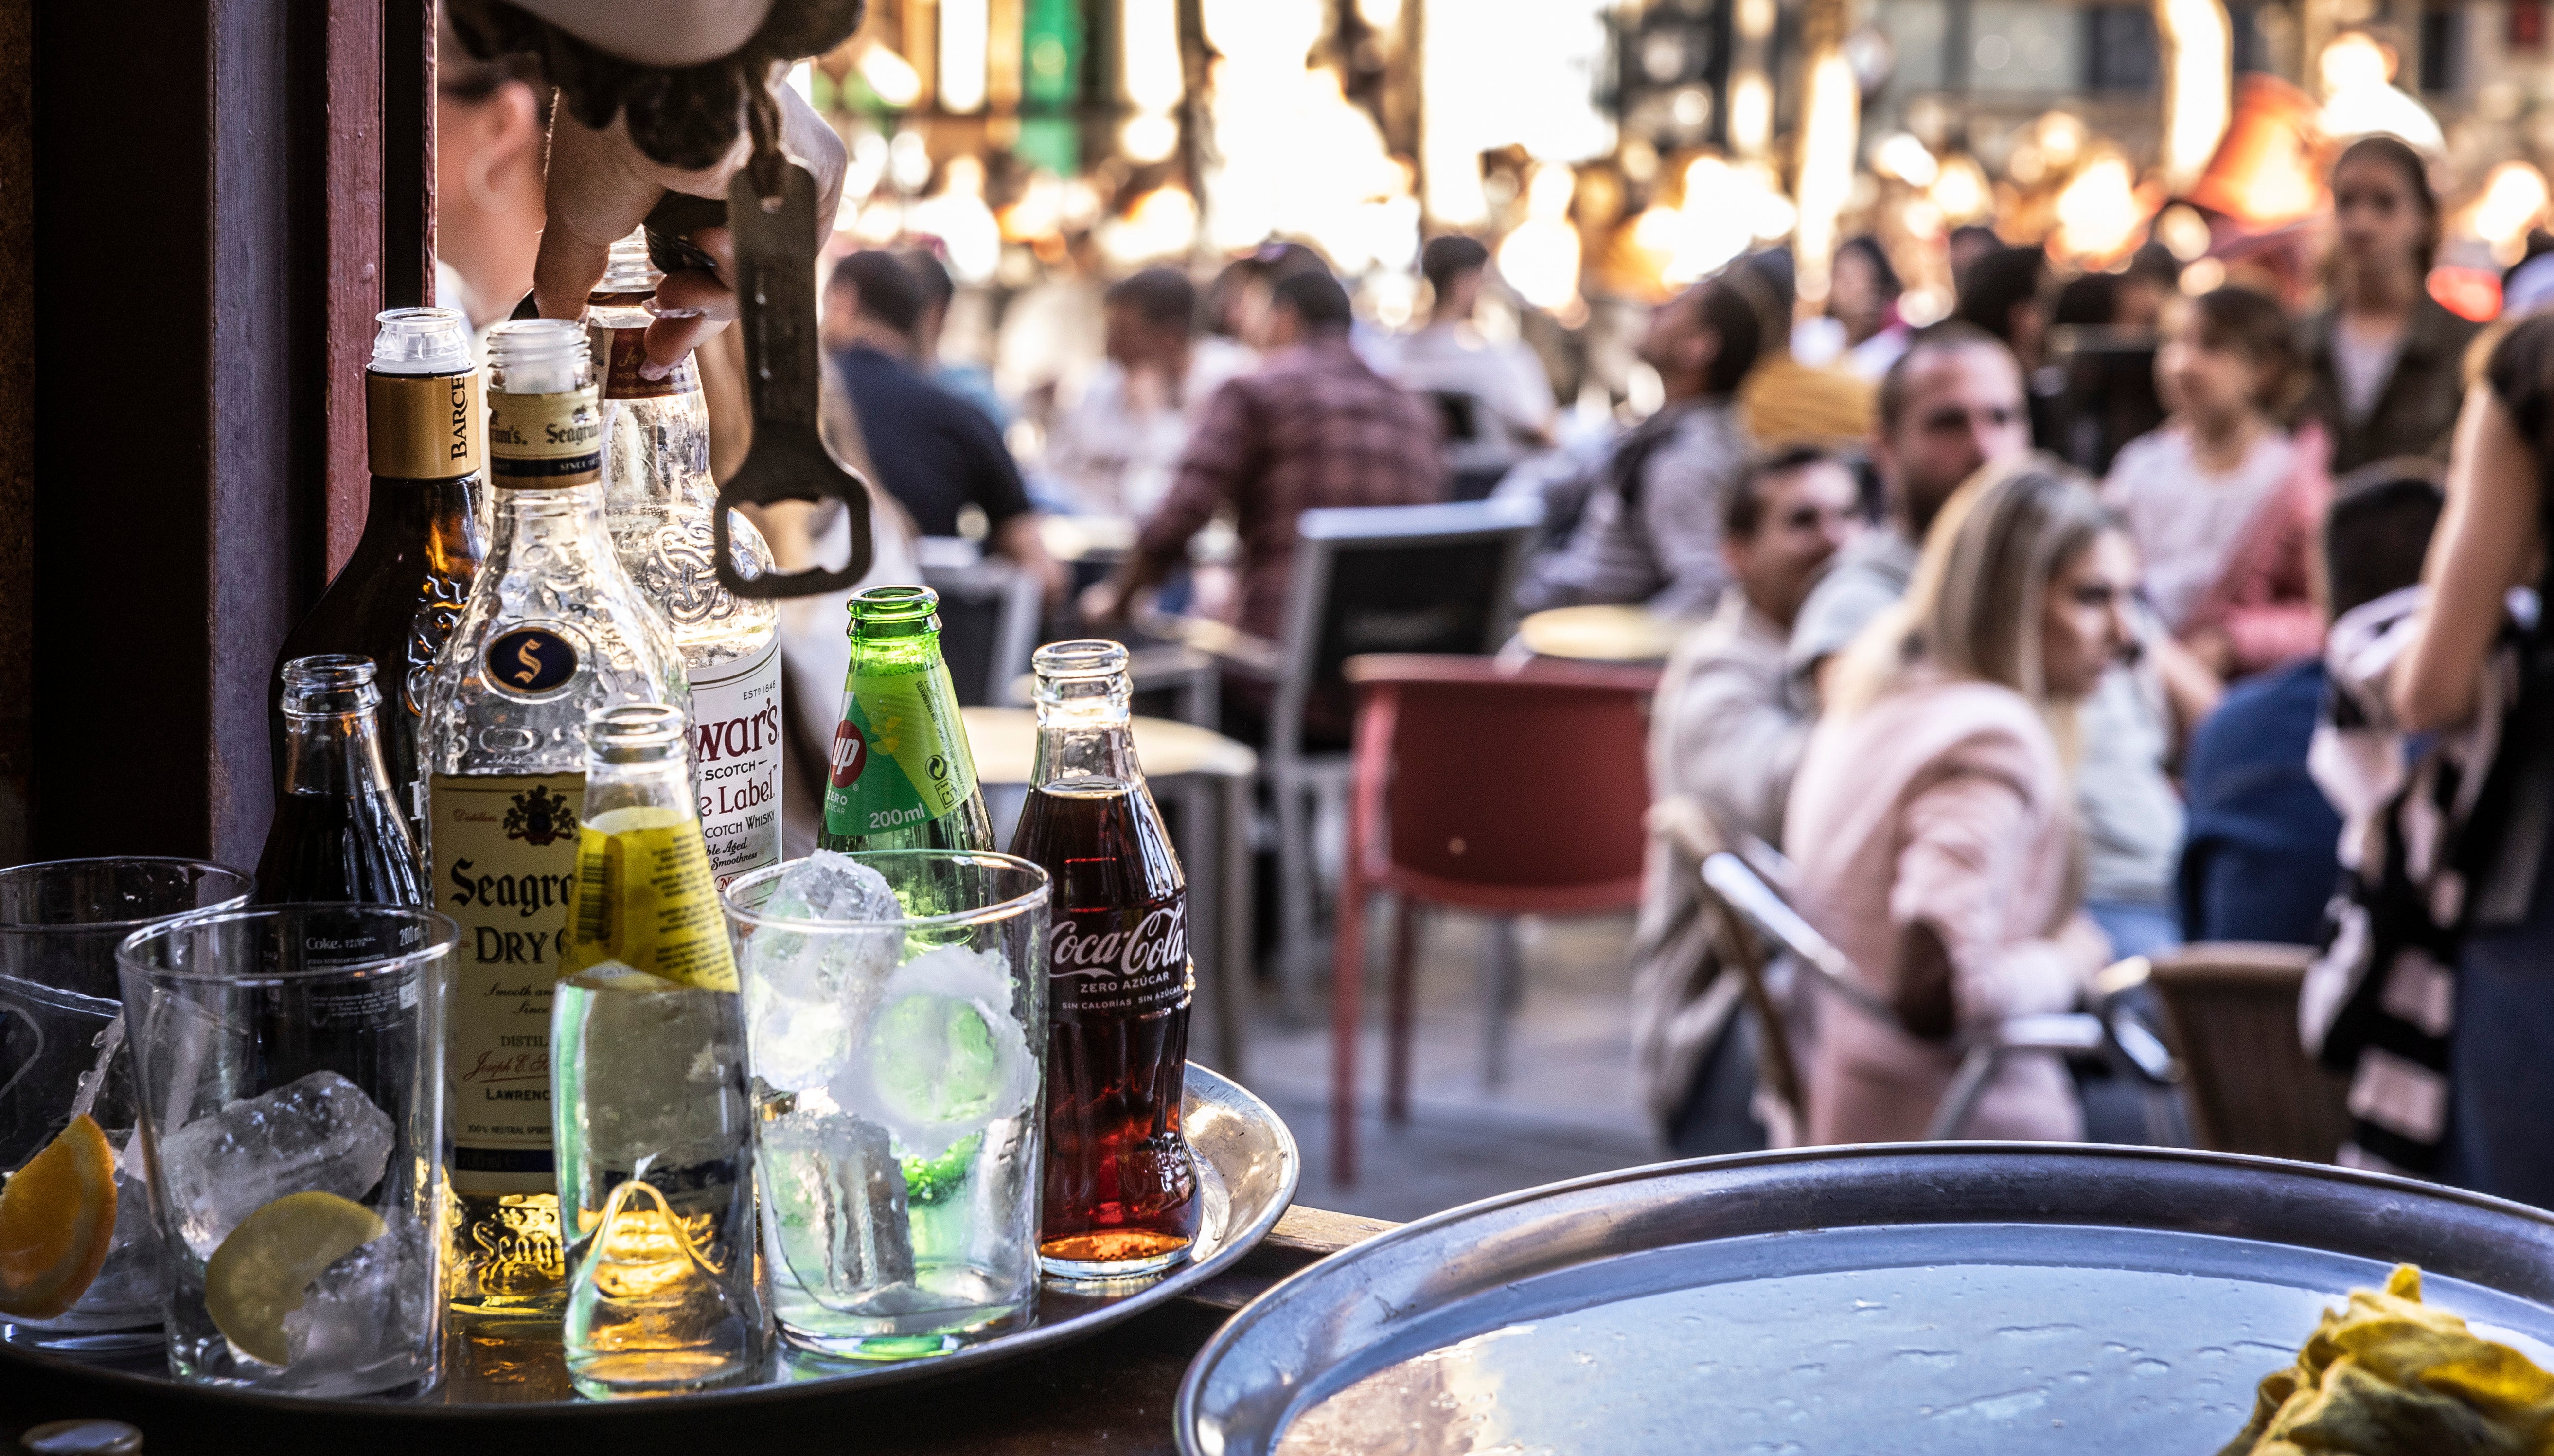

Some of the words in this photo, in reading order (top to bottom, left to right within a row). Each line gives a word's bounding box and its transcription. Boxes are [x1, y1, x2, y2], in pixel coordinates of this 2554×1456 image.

[514, 638, 543, 684] S
[763, 680, 776, 694] 1846
[915, 680, 934, 714] COLORANTES
[698, 697, 778, 763] war's
[705, 760, 756, 781] SCOTCH
[705, 821, 743, 839] COTCH
[745, 809, 775, 830] WHISKY
[723, 837, 747, 856] Aged
[710, 852, 758, 871] Smoothness
[475, 925, 549, 964] DRY
[1049, 901, 1185, 977] Coca-Cola
[484, 981, 532, 996] Smooth
[1080, 981, 1117, 993] ZERO
[1122, 971, 1169, 990] AZÚCAR
[1082, 998, 1132, 1010] CALORÍAS
[1138, 995, 1153, 1005] SIN
[1155, 985, 1181, 1001] AZÚCAR
[500, 1035, 548, 1047] DISTIL
[486, 1087, 550, 1101] LAWRENC
